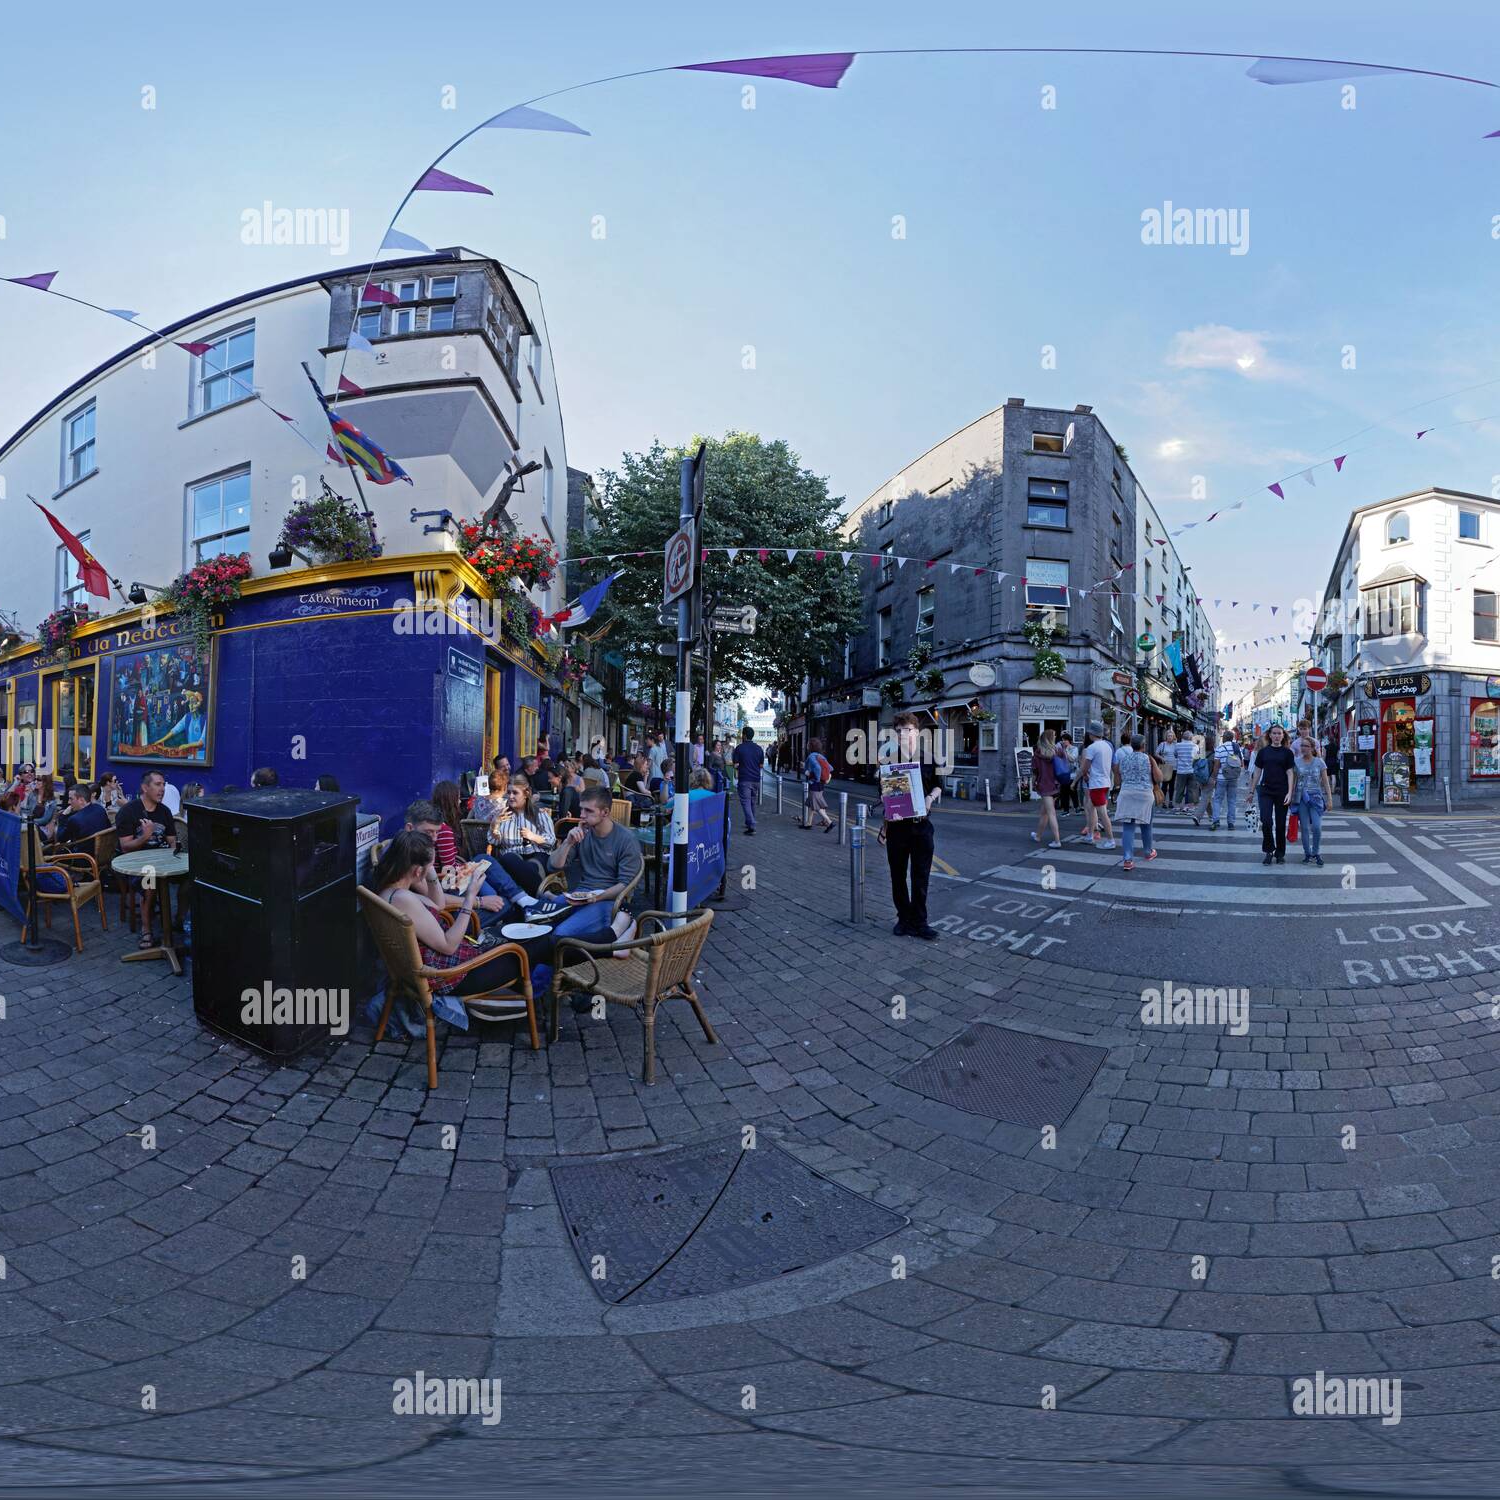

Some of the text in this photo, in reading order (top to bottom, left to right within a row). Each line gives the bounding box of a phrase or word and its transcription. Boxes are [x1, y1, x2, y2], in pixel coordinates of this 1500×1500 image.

[1377, 685, 1418, 696] Sweater Shop
[1380, 677, 1414, 687] FALLER'S
[969, 894, 1081, 926] LOOK
[928, 914, 1067, 956] RIGHT
[1335, 920, 1476, 945] LOOK
